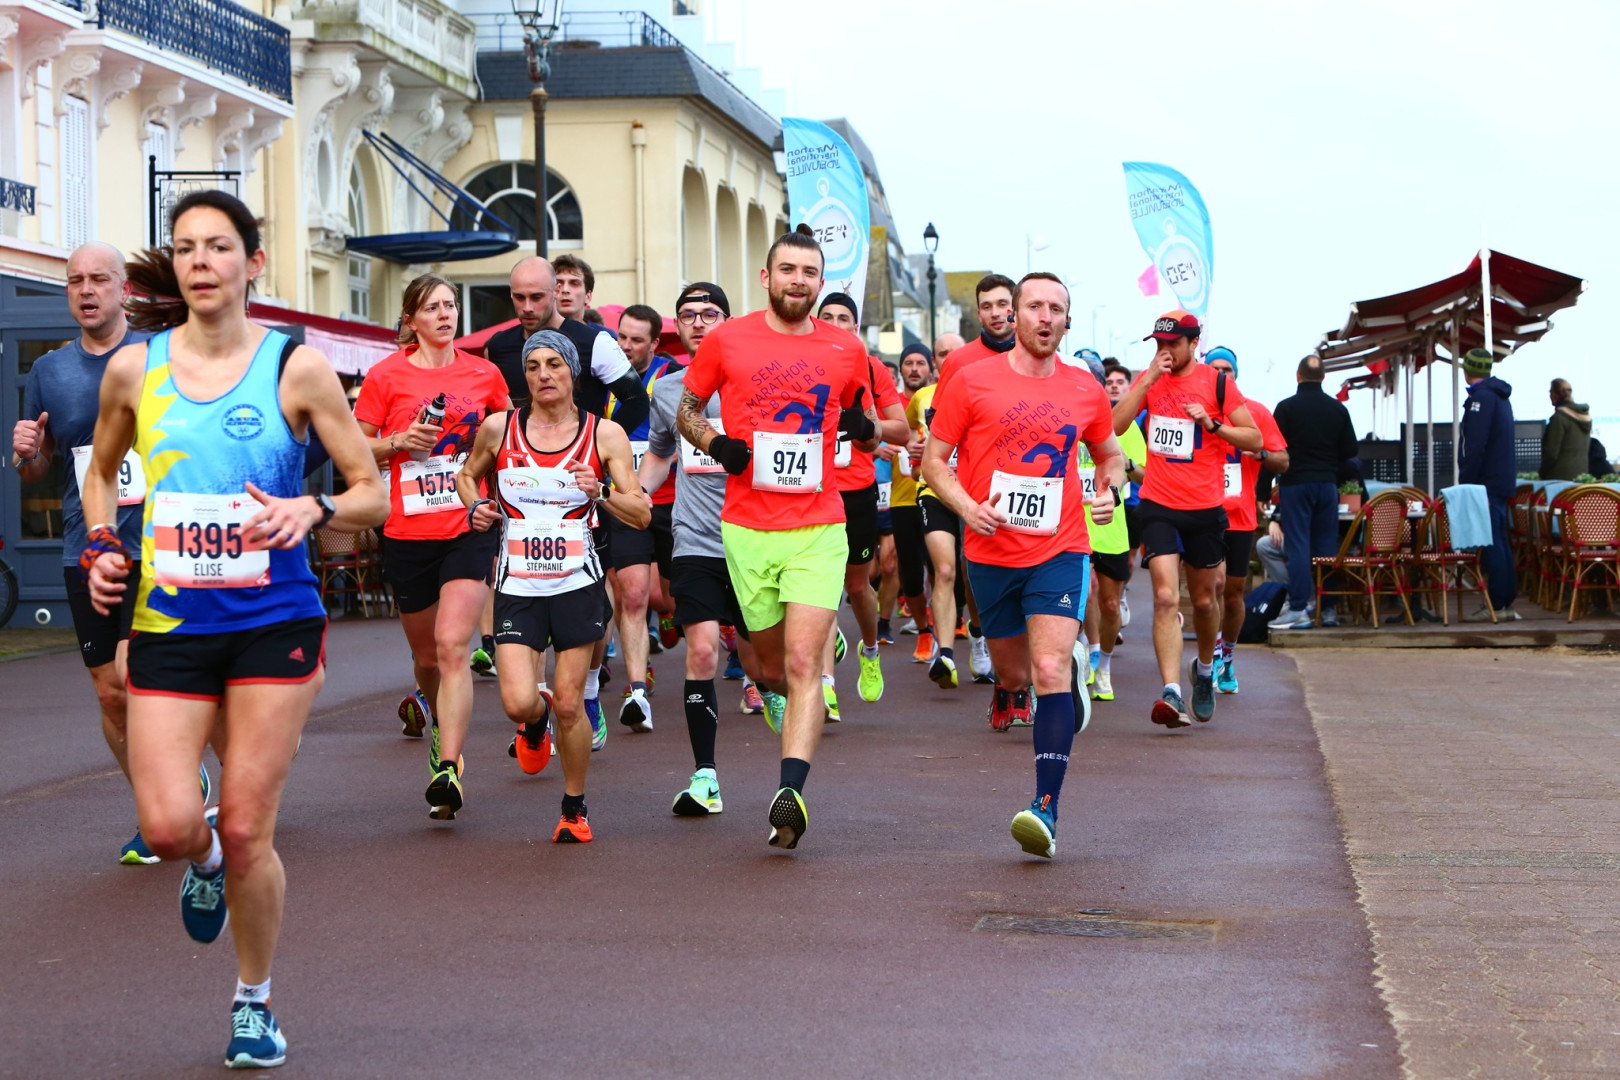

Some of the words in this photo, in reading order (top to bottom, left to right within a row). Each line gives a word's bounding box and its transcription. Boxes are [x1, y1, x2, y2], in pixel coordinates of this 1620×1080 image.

[745, 360, 809, 410] MARATHON
[751, 360, 782, 386] SEMI
[749, 366, 825, 427] CABOURG
[994, 400, 1055, 452] MARATHON
[1000, 400, 1030, 428] SEMI
[996, 407, 1071, 468] CABOURG
[1154, 427, 1183, 446] 2079
[773, 450, 807, 475] 974
[416, 471, 457, 497] 1575
[778, 476, 802, 486] PIERRE
[426, 495, 454, 506] PAULINE
[1008, 491, 1046, 518] 1761
[1010, 516, 1040, 528] LUDOVIC
[174, 522, 242, 559] 1395
[522, 536, 566, 561] 1886
[194, 563, 223, 576] ELISE
[526, 562, 563, 571] STÉPHANIE
